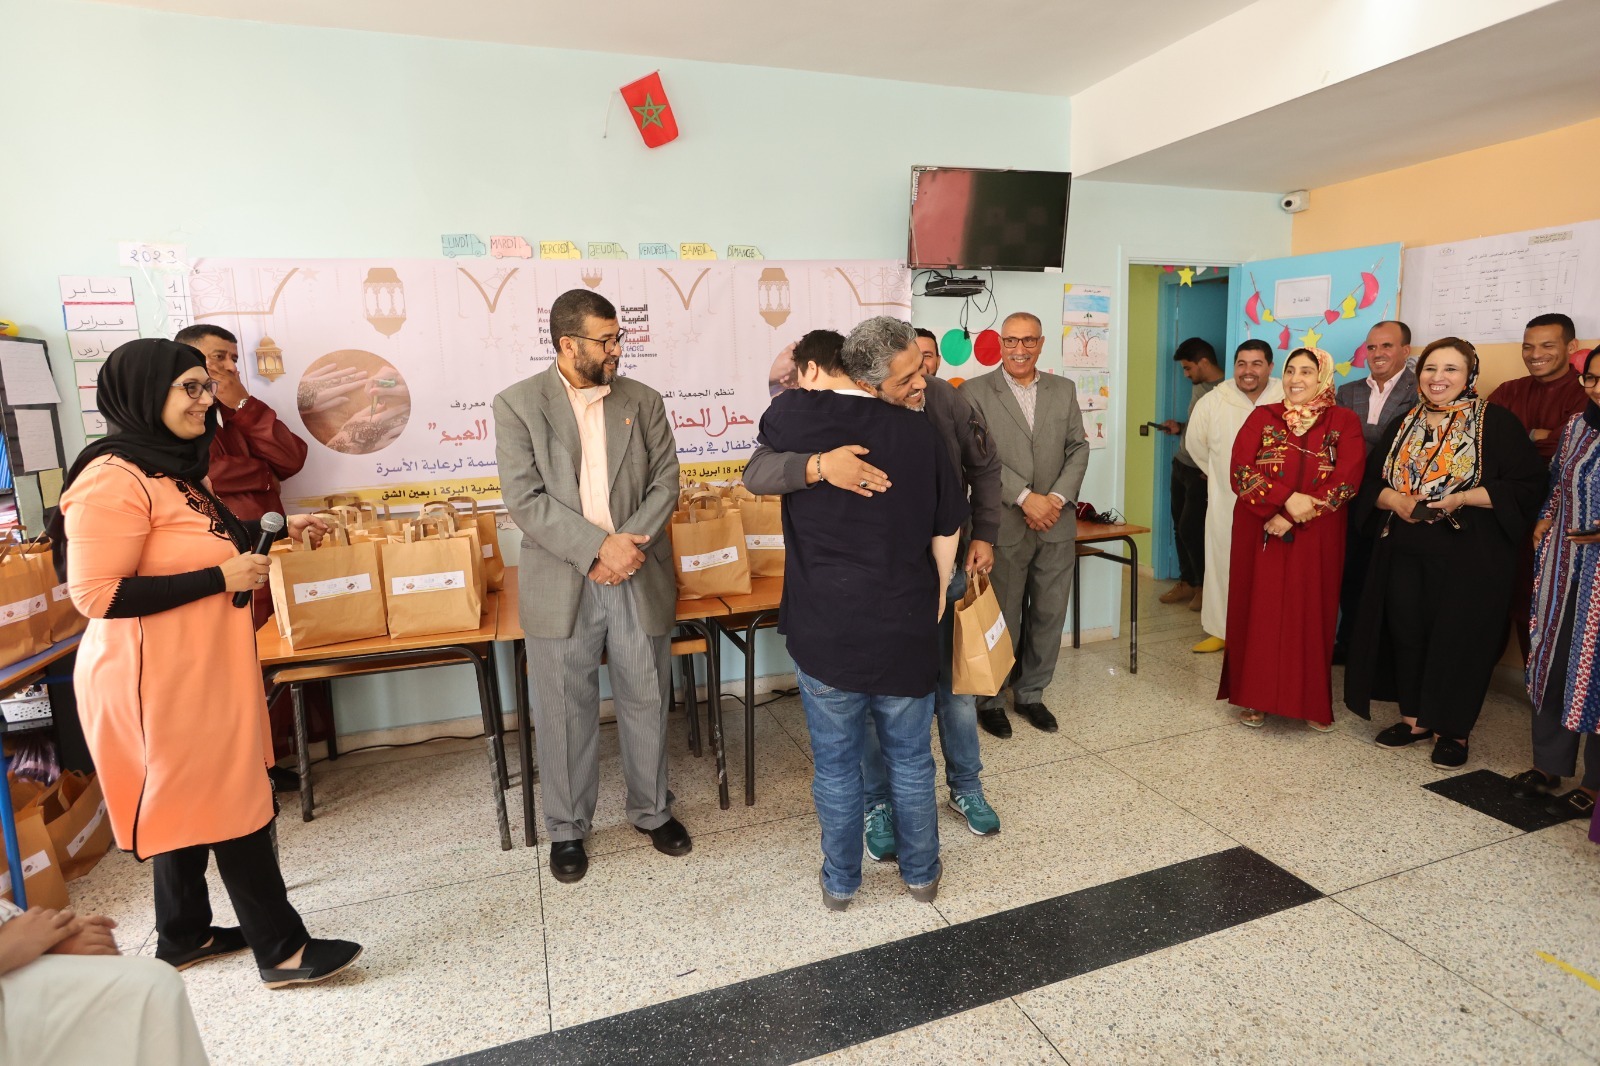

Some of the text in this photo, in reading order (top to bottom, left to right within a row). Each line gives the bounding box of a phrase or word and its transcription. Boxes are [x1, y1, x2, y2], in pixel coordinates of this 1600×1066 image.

[130, 249, 177, 264] 2023
[67, 278, 117, 298] يناير
[168, 279, 178, 293] 1
[621, 304, 648, 313] الجمعية
[621, 314, 649, 324] المغربية
[77, 339, 112, 359] ارس
[679, 389, 711, 401] الجمعية
[713, 388, 735, 400] تنظم
[450, 400, 486, 411] معروف
[705, 405, 754, 437] حفل
[706, 441, 719, 454] في
[376, 458, 418, 477] الأسرة
[421, 458, 463, 474] لرعاية
[723, 466, 731, 474] 18
[381, 489, 406, 501] الشق
[408, 489, 431, 499] بعين
[440, 485, 469, 496] البركة
